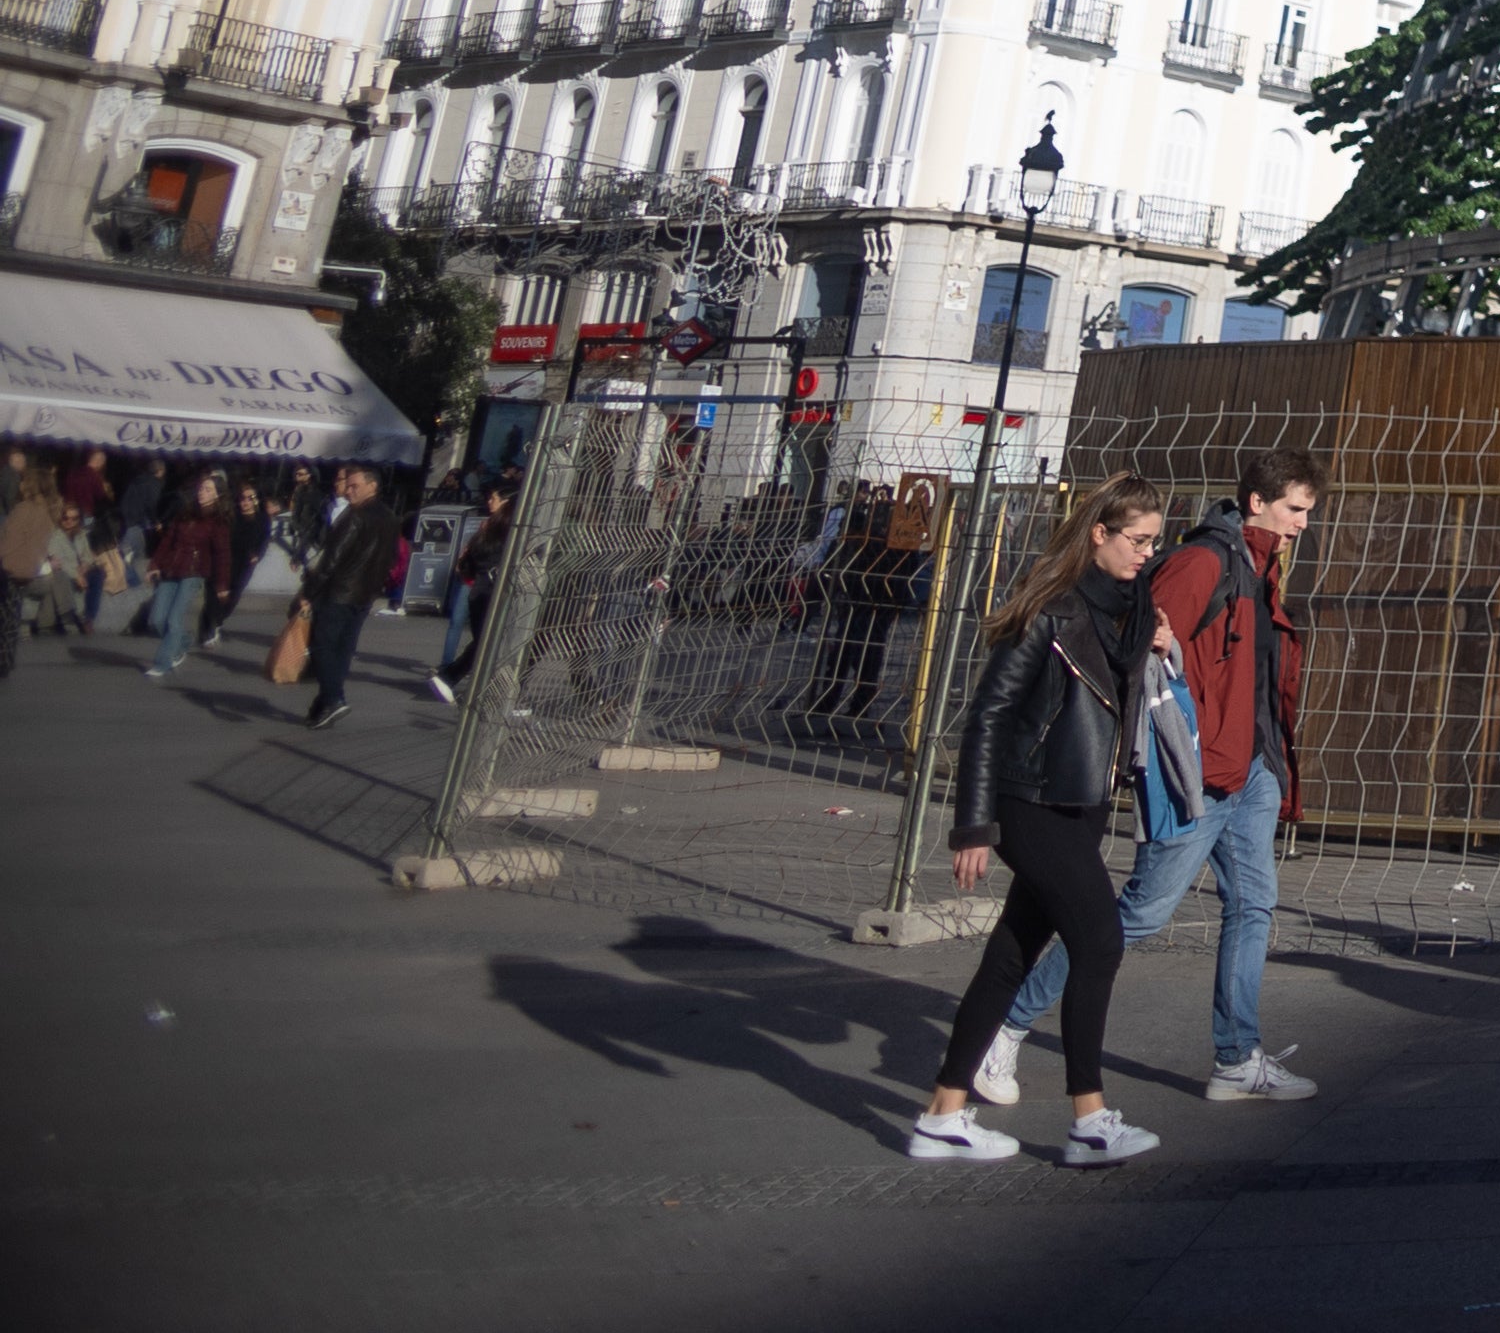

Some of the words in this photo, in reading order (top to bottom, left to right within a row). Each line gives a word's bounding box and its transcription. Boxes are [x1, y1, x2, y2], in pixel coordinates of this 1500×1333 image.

[500, 335, 548, 349] SOUVENIRS
[673, 335, 698, 346] Metro
[125, 367, 171, 382] DE
[167, 360, 353, 396] DIEGO
[219, 397, 359, 416] PARAGUAS
[116, 420, 189, 447] CASA
[194, 436, 215, 446] DE
[217, 427, 303, 451] DIEGO
